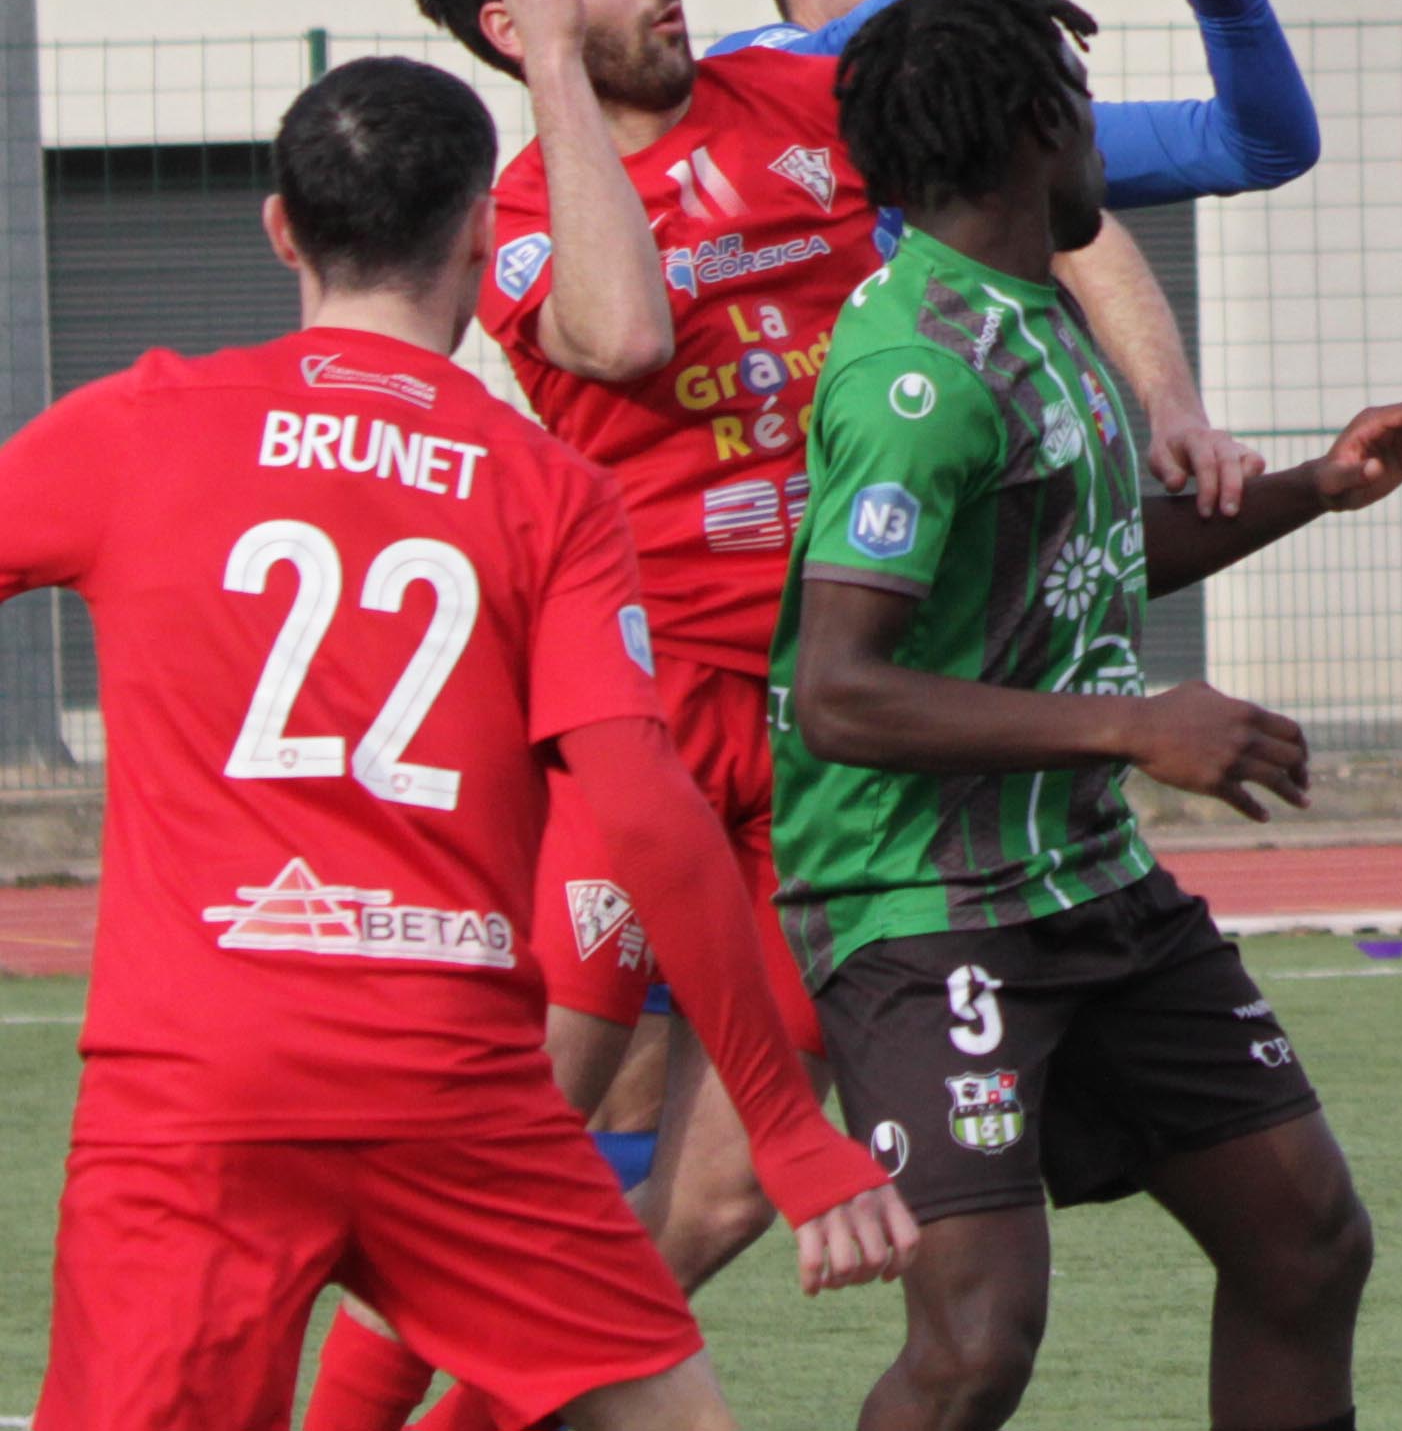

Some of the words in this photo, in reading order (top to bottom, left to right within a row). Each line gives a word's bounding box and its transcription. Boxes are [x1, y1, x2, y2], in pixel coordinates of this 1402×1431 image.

[696, 233, 743, 264] AIR
[699, 235, 830, 283] CORSICA
[727, 304, 789, 344] La
[674, 332, 832, 411] Grand
[258, 409, 489, 501] BRUNET
[857, 500, 908, 543] N3
[222, 518, 480, 812] 22
